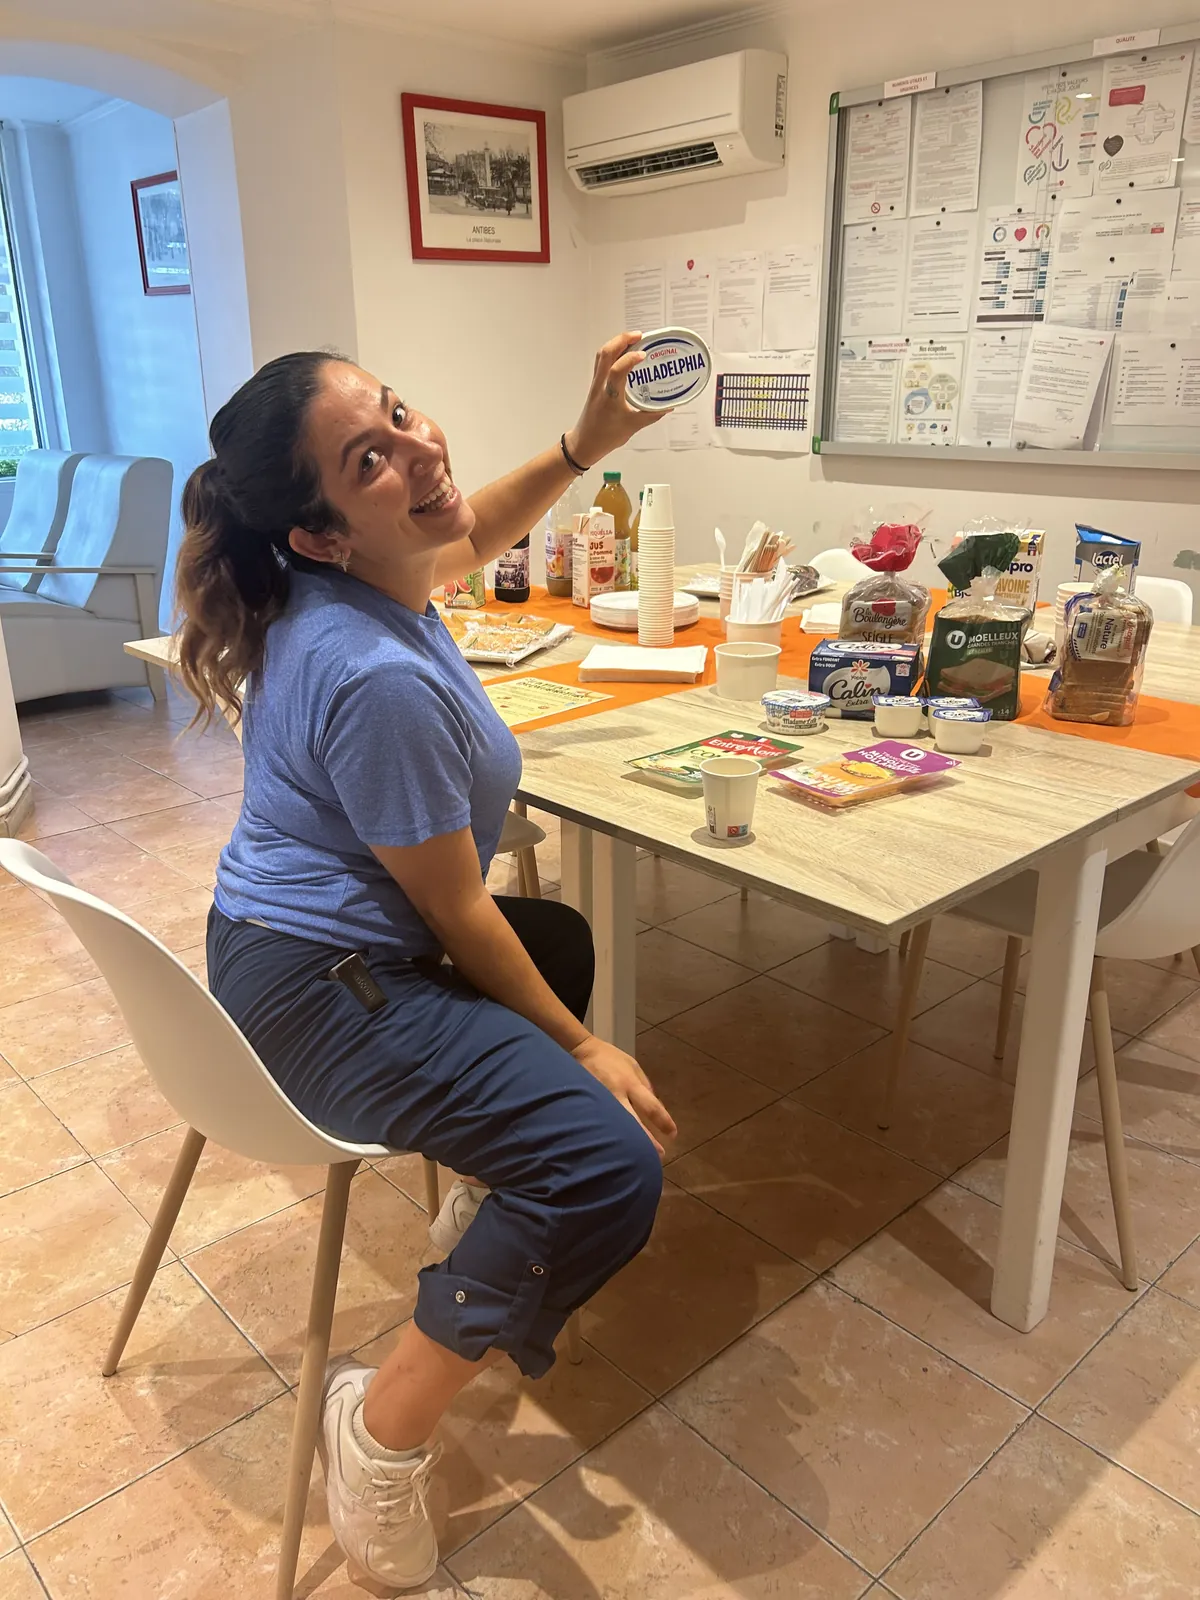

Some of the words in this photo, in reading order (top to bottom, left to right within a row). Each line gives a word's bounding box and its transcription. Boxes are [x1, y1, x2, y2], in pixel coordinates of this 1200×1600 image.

[472, 226, 496, 234] ANTIBES
[650, 348, 678, 360] ORIGINAL
[628, 353, 706, 388] PHILADELPHIA
[590, 541, 604, 550] JUS
[1092, 552, 1124, 567] lactel
[1007, 562, 1033, 574] pro
[995, 578, 1030, 594] AVOINE
[853, 607, 907, 629] Boulangère
[968, 632, 1018, 644] MOELLEUX
[1100, 618, 1115, 649] Nature
[829, 680, 885, 700] Calin
[846, 699, 869, 707] Extra
